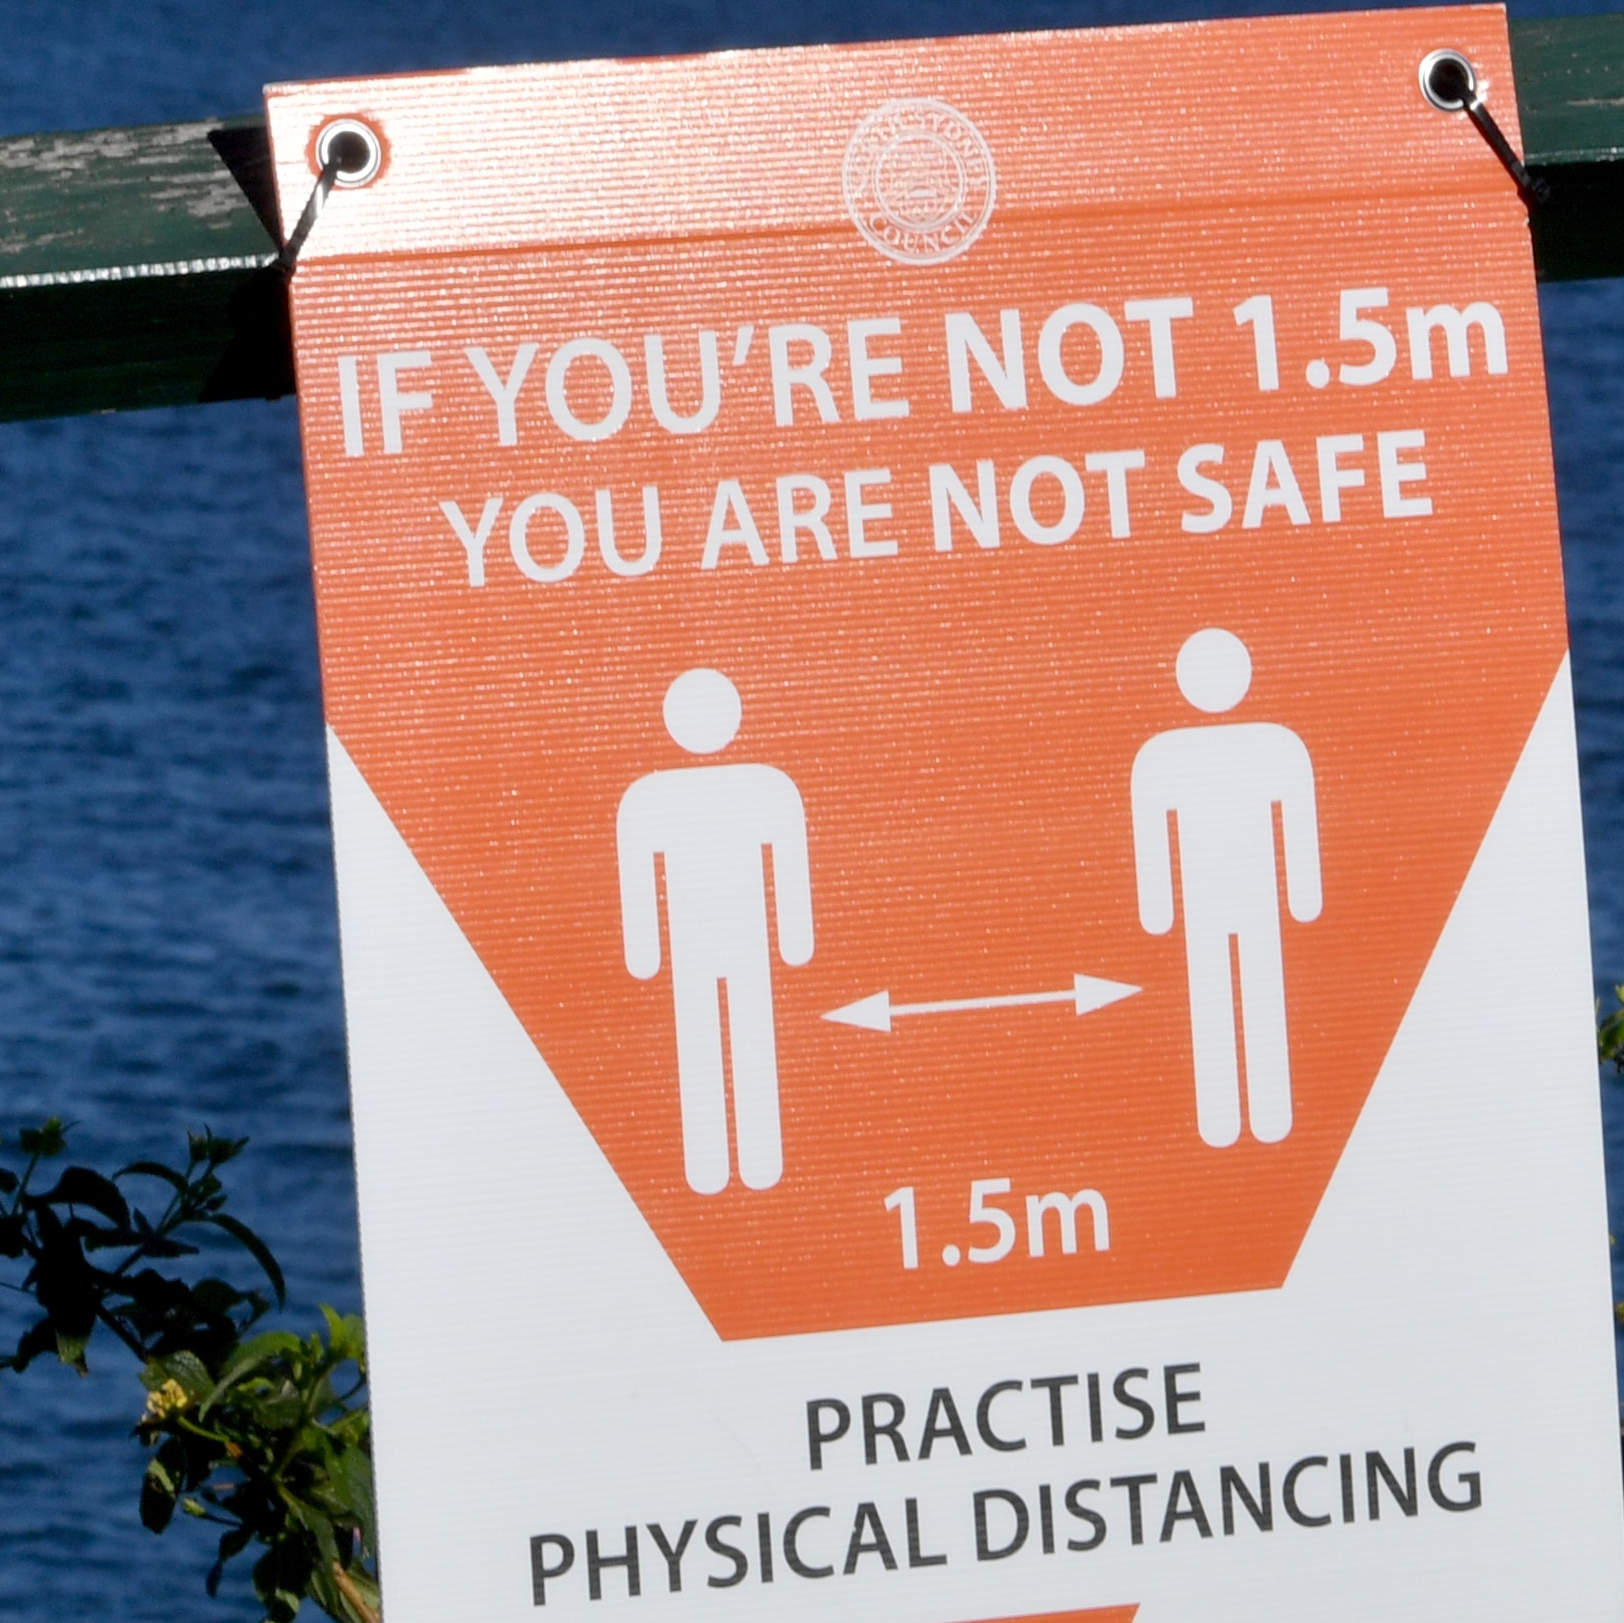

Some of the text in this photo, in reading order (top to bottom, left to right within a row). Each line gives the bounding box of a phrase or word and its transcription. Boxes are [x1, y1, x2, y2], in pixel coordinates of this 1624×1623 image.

[869, 210, 977, 253] COUNCIL
[334, 341, 435, 459] IF
[943, 295, 1195, 414] NOT
[1232, 285, 1510, 392] 1.5m
[438, 428, 1434, 588] YOU ARE NOT SAFE
[883, 1178, 1111, 1269] 1.5m
[806, 1362, 1206, 1471] PRACTISE
[529, 1440, 1483, 1607] PHYSICAL DISTANCING
